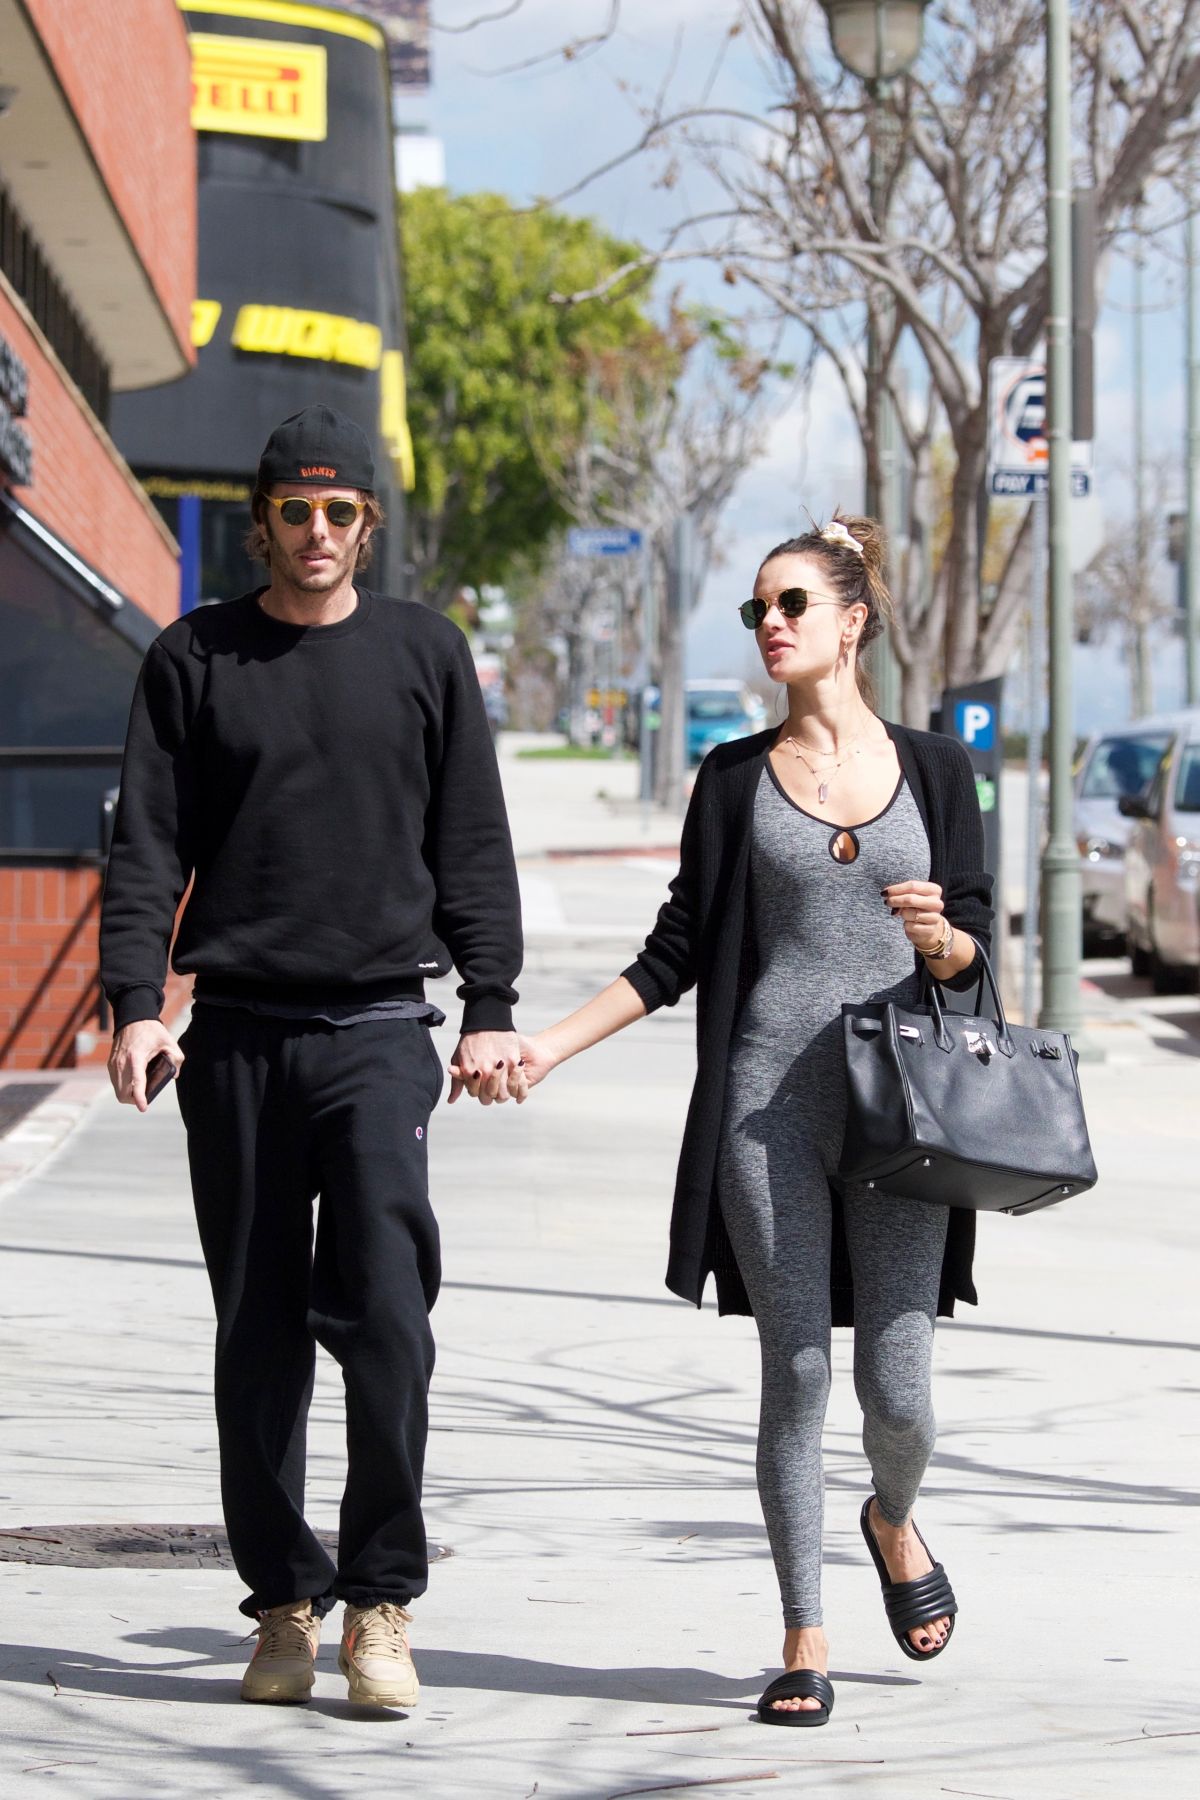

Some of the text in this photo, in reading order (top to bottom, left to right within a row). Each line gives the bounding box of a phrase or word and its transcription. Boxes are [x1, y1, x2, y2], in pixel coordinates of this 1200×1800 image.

[191, 84, 299, 115] ELLI
[301, 466, 336, 479] GIANTS
[996, 475, 1085, 494] PAY HE
[963, 704, 990, 743] P
